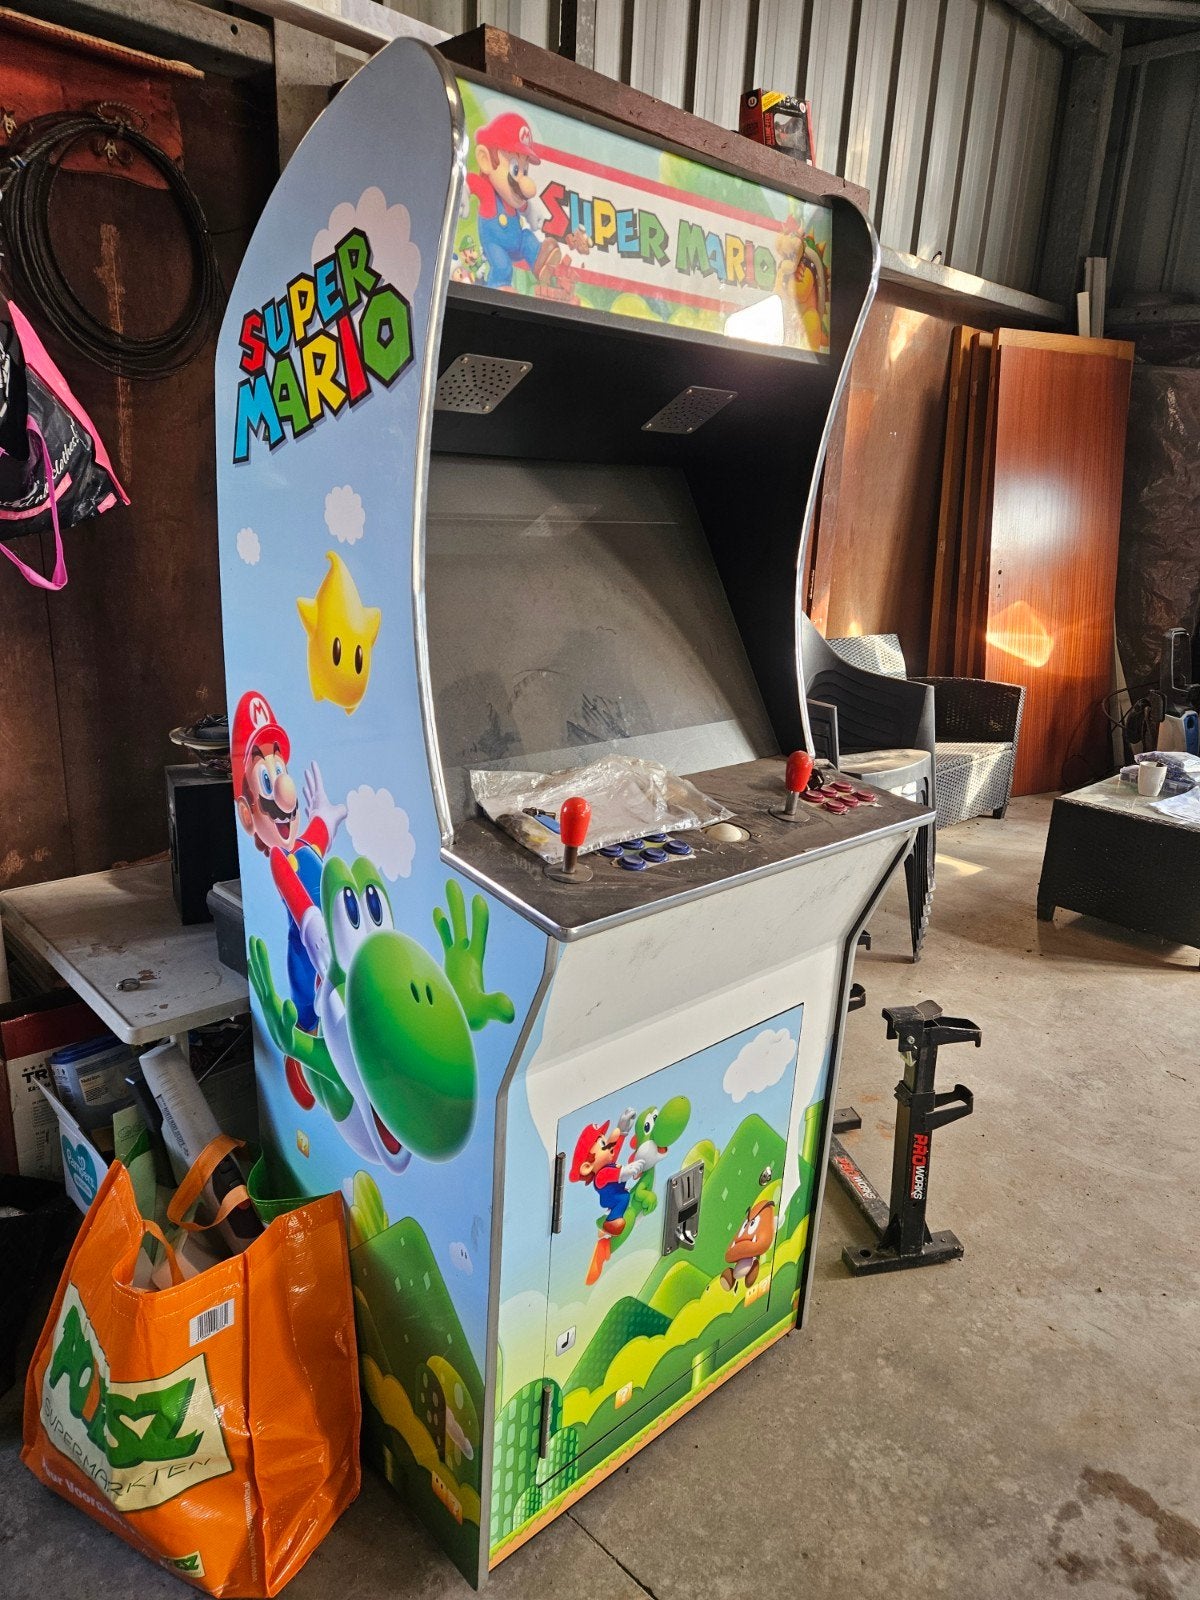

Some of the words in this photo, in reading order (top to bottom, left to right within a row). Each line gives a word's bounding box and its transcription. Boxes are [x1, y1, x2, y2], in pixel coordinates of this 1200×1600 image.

[541, 181, 670, 267] SUPER
[675, 219, 778, 291] MARIO
[238, 227, 382, 376] SUPER
[233, 283, 414, 464] MARIO
[44, 1397, 211, 1497] SUPERMARKTEN
